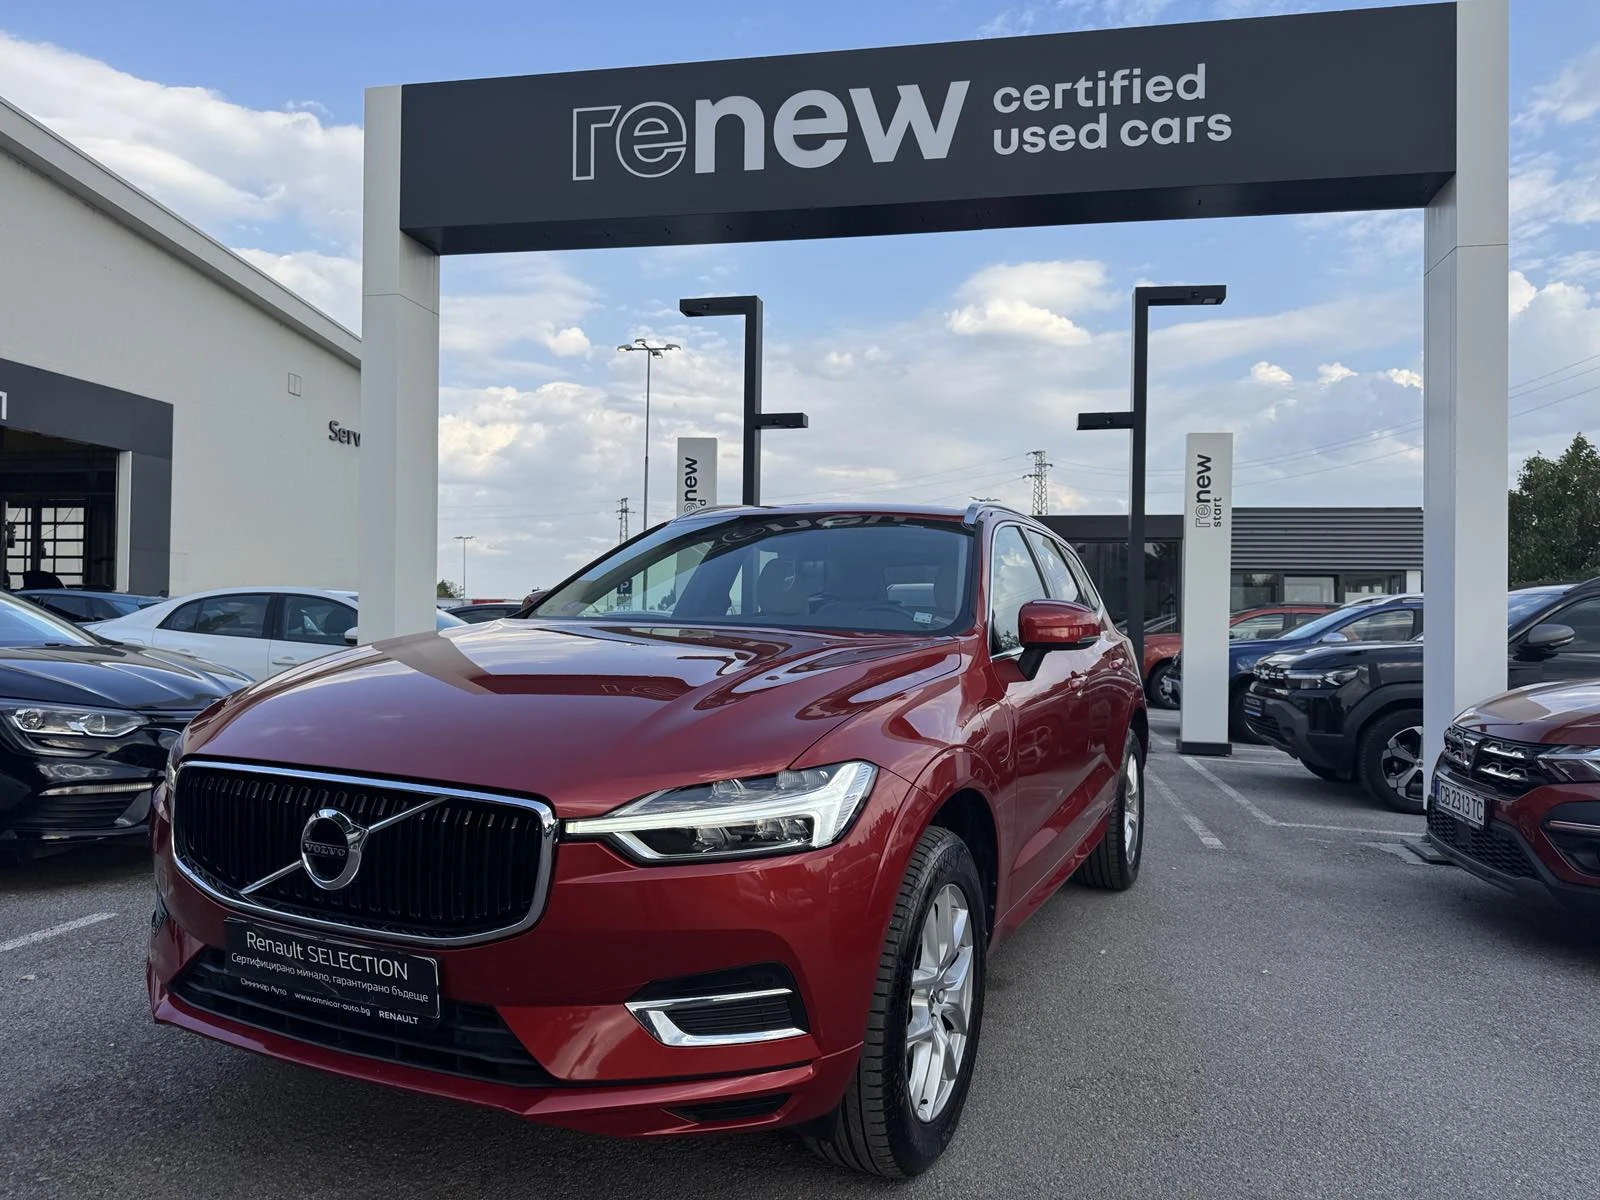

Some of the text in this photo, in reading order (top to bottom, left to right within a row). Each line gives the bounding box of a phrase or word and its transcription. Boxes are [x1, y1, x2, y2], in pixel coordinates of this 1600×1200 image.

[992, 63, 1206, 114] certified
[572, 80, 970, 182] renew
[993, 113, 1233, 156] used cars
[684, 456, 698, 513] enew
[1195, 454, 1212, 528] renew
[1212, 497, 1222, 528] start
[1441, 785, 1484, 821] CB 2313 TC
[304, 842, 346, 857] VOLVO
[231, 952, 429, 1003] Сертифицирано минало, гарантирано бъдеще
[246, 931, 409, 981] Renault SELECTION
[294, 991, 371, 1017] www.omnicar-auto.bg
[378, 1010, 419, 1025] RENAULT
